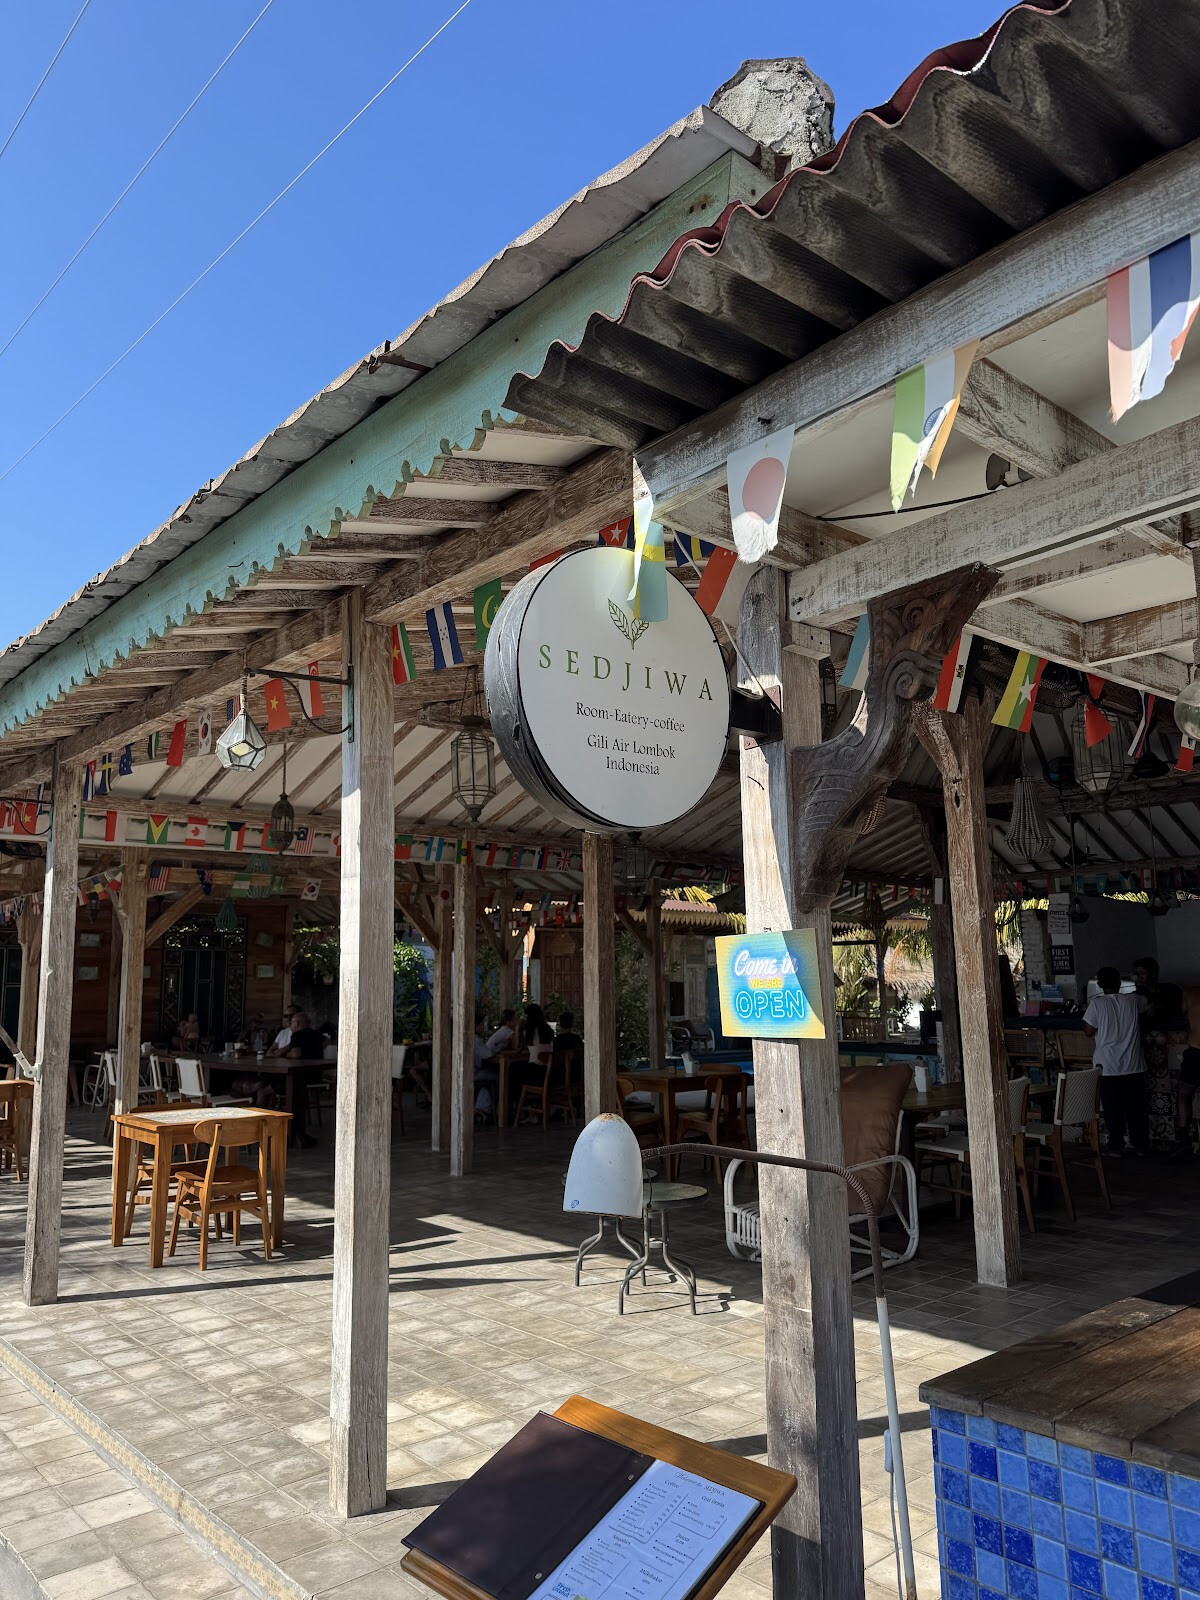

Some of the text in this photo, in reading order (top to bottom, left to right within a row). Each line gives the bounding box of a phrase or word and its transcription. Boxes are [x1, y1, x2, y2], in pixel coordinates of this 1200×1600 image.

[539, 644, 713, 701] SEDJIWA
[575, 701, 686, 732] Room-Eatery-coffee
[587, 734, 676, 759] Gili Air Lombok
[606, 756, 660, 775] Indonesia
[734, 949, 799, 976] Come in
[1052, 948, 1070, 956] FIRST
[749, 977, 783, 989] WE ARE
[736, 990, 805, 1018] OPEN
[664, 1479, 680, 1489] Coffee
